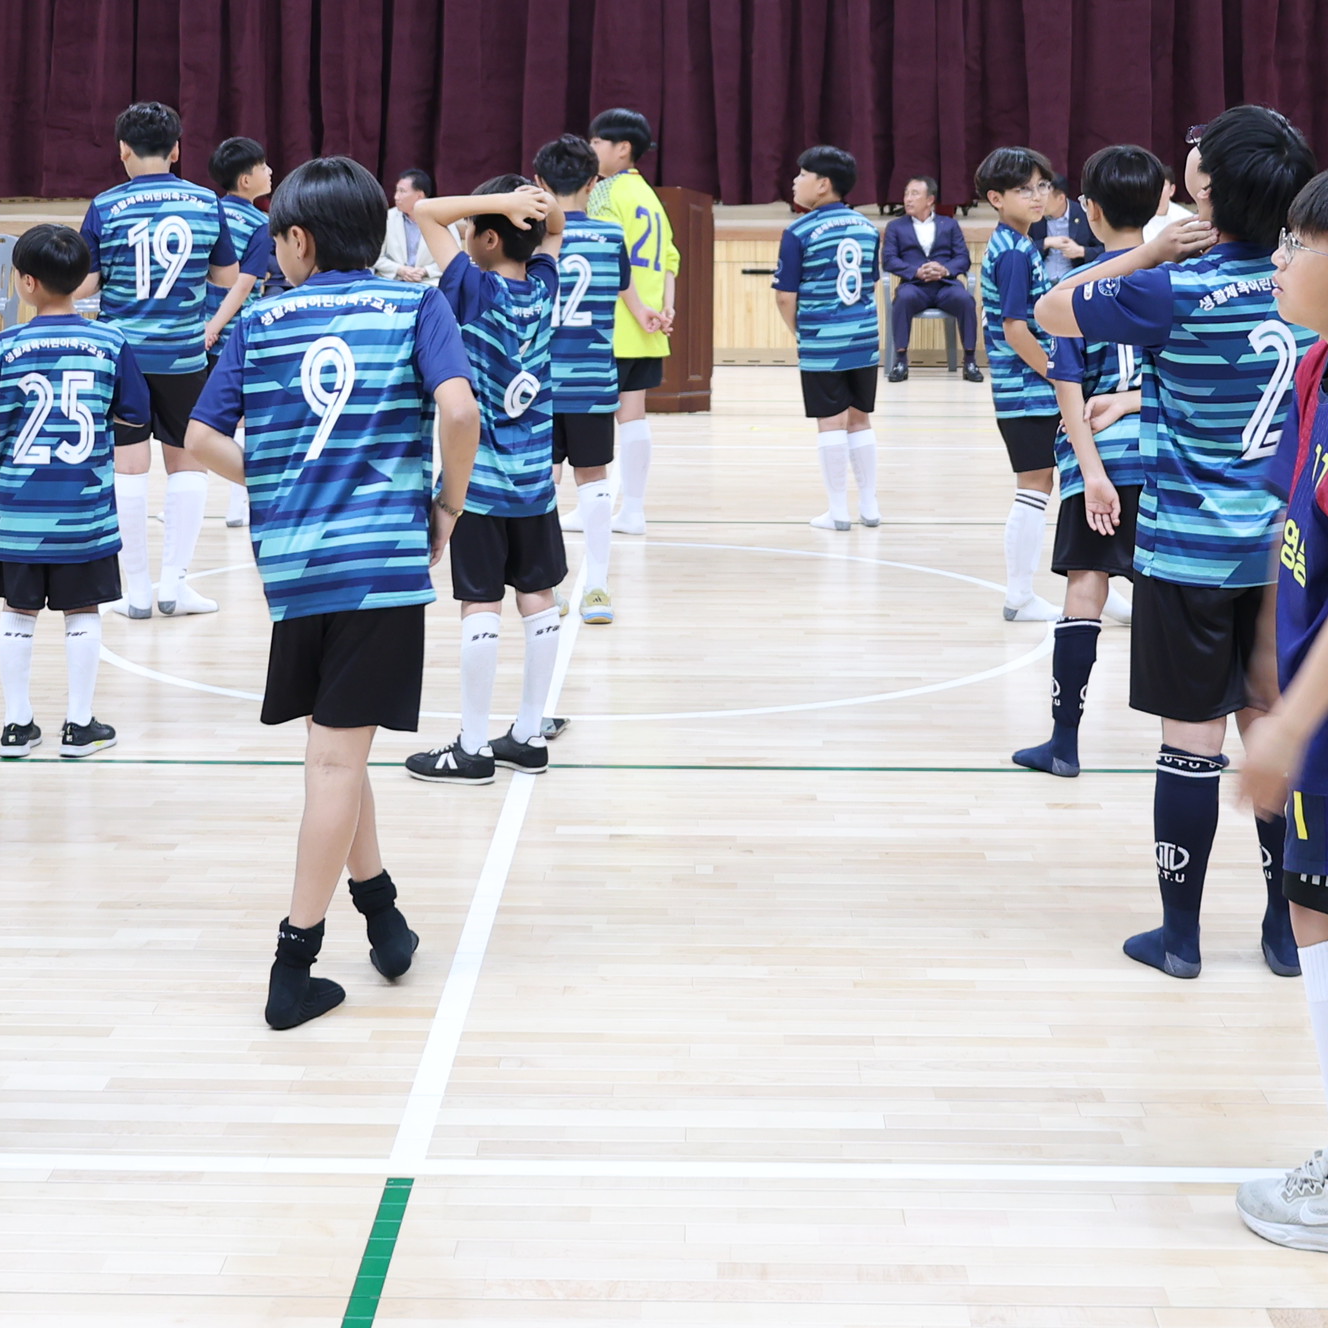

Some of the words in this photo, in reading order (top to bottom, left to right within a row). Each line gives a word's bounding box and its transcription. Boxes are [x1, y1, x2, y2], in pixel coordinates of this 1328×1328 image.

[128, 215, 193, 300] 19
[630, 205, 662, 272] 21
[836, 237, 862, 306] 8
[12, 370, 95, 465] 25
[300, 335, 356, 463] 9
[1241, 319, 1297, 460] 2
